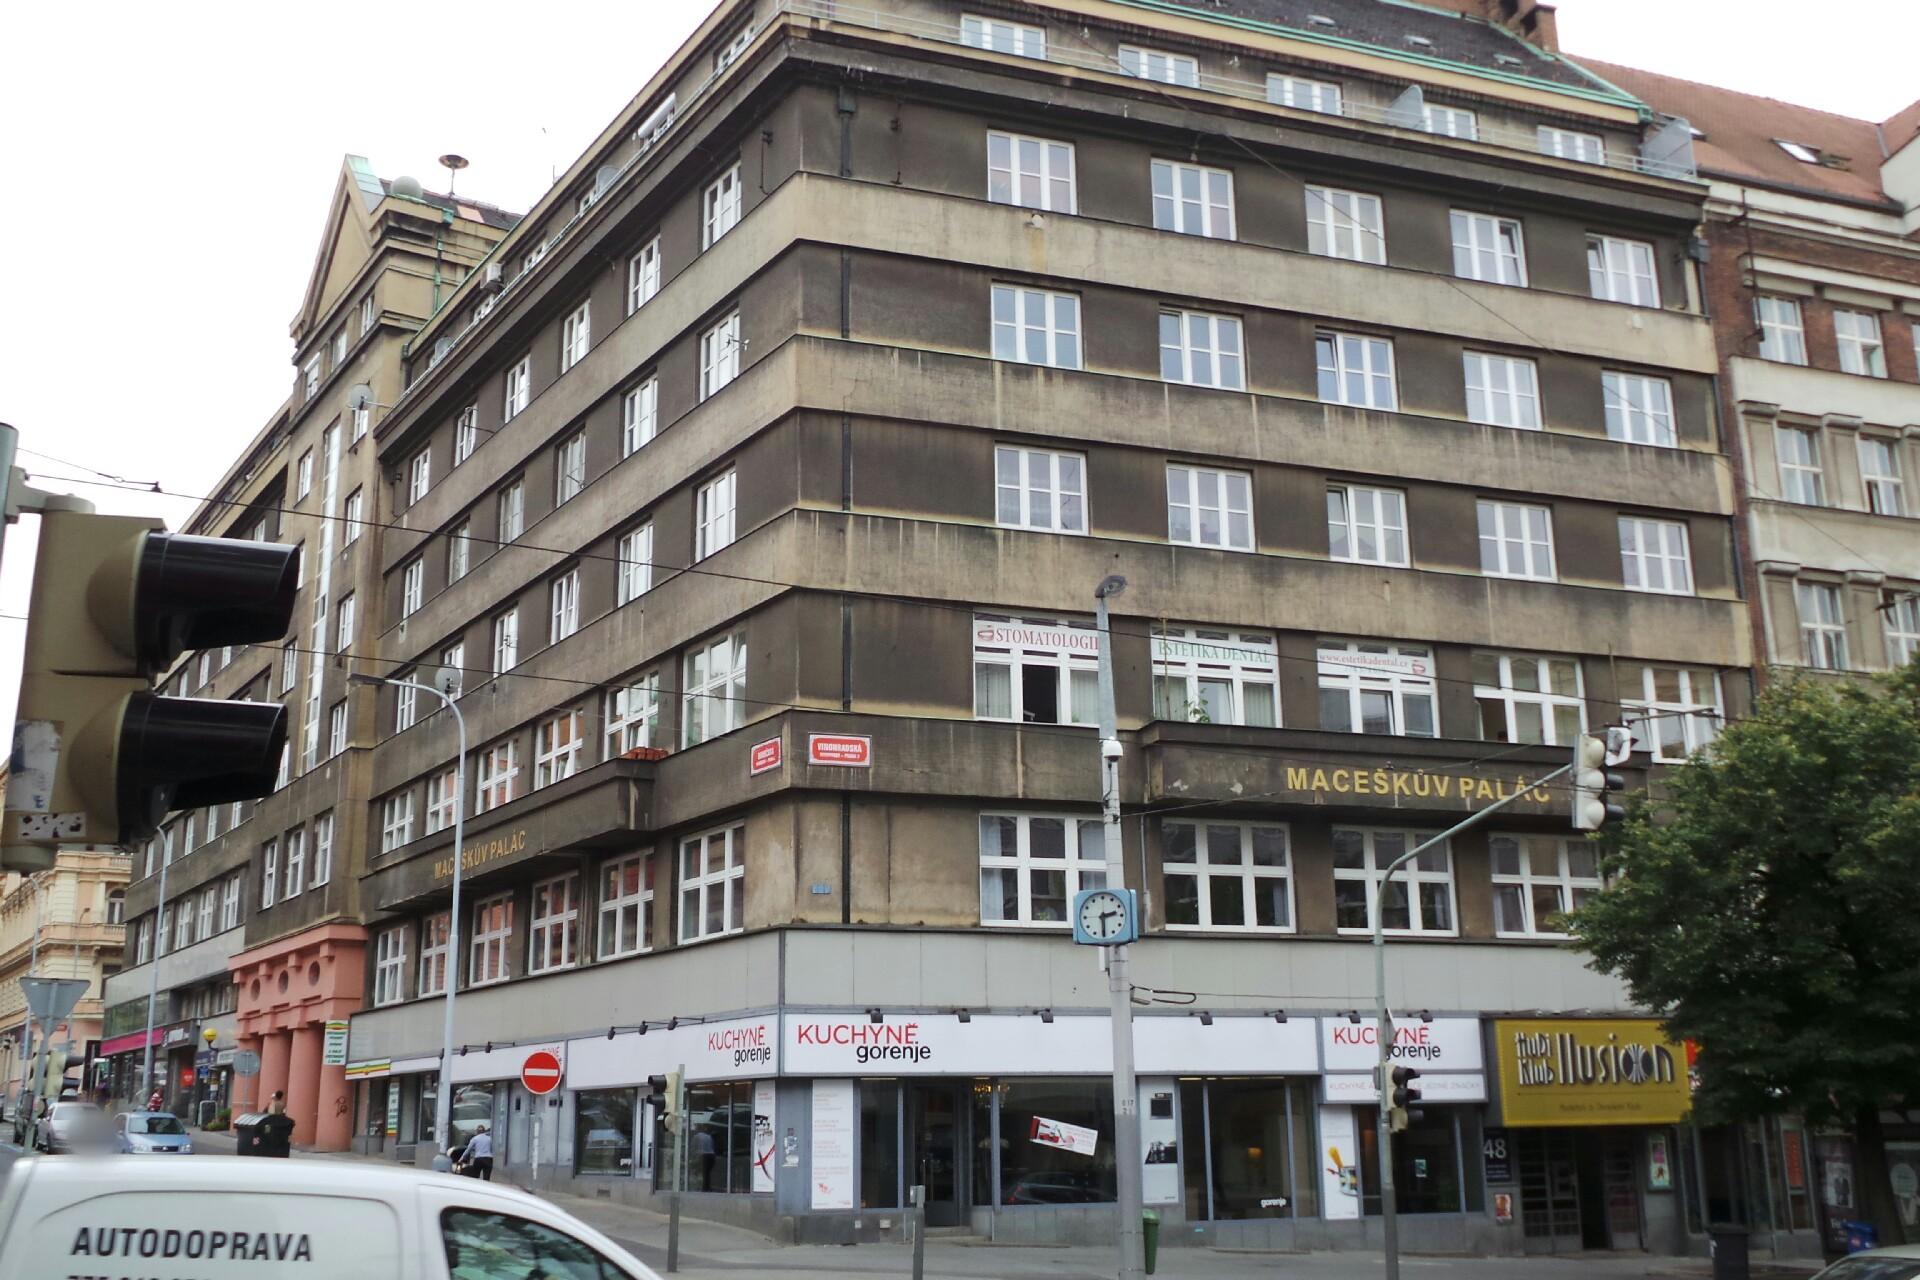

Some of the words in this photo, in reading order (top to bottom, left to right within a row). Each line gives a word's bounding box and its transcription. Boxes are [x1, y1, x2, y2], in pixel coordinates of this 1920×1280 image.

[1158, 642, 1219, 659] ESTETIKA
[1222, 648, 1271, 664] DENTAL
[1287, 767, 1449, 797] MACEŠKŮV
[434, 842, 488, 880] MACŠKŮV
[490, 828, 526, 860] PALÁC
[708, 1025, 766, 1050] KUCHYNĚ
[797, 1023, 919, 1044] KUCHYNĚ
[1334, 1025, 1430, 1044] KUCYNĚ
[734, 1042, 771, 1067] gorenje
[856, 1041, 931, 1063] gorenje
[1556, 1032, 1674, 1085] Illusion
[1483, 1139, 1507, 1159] 48
[70, 1226, 313, 1262] AUTODOPRAVA
